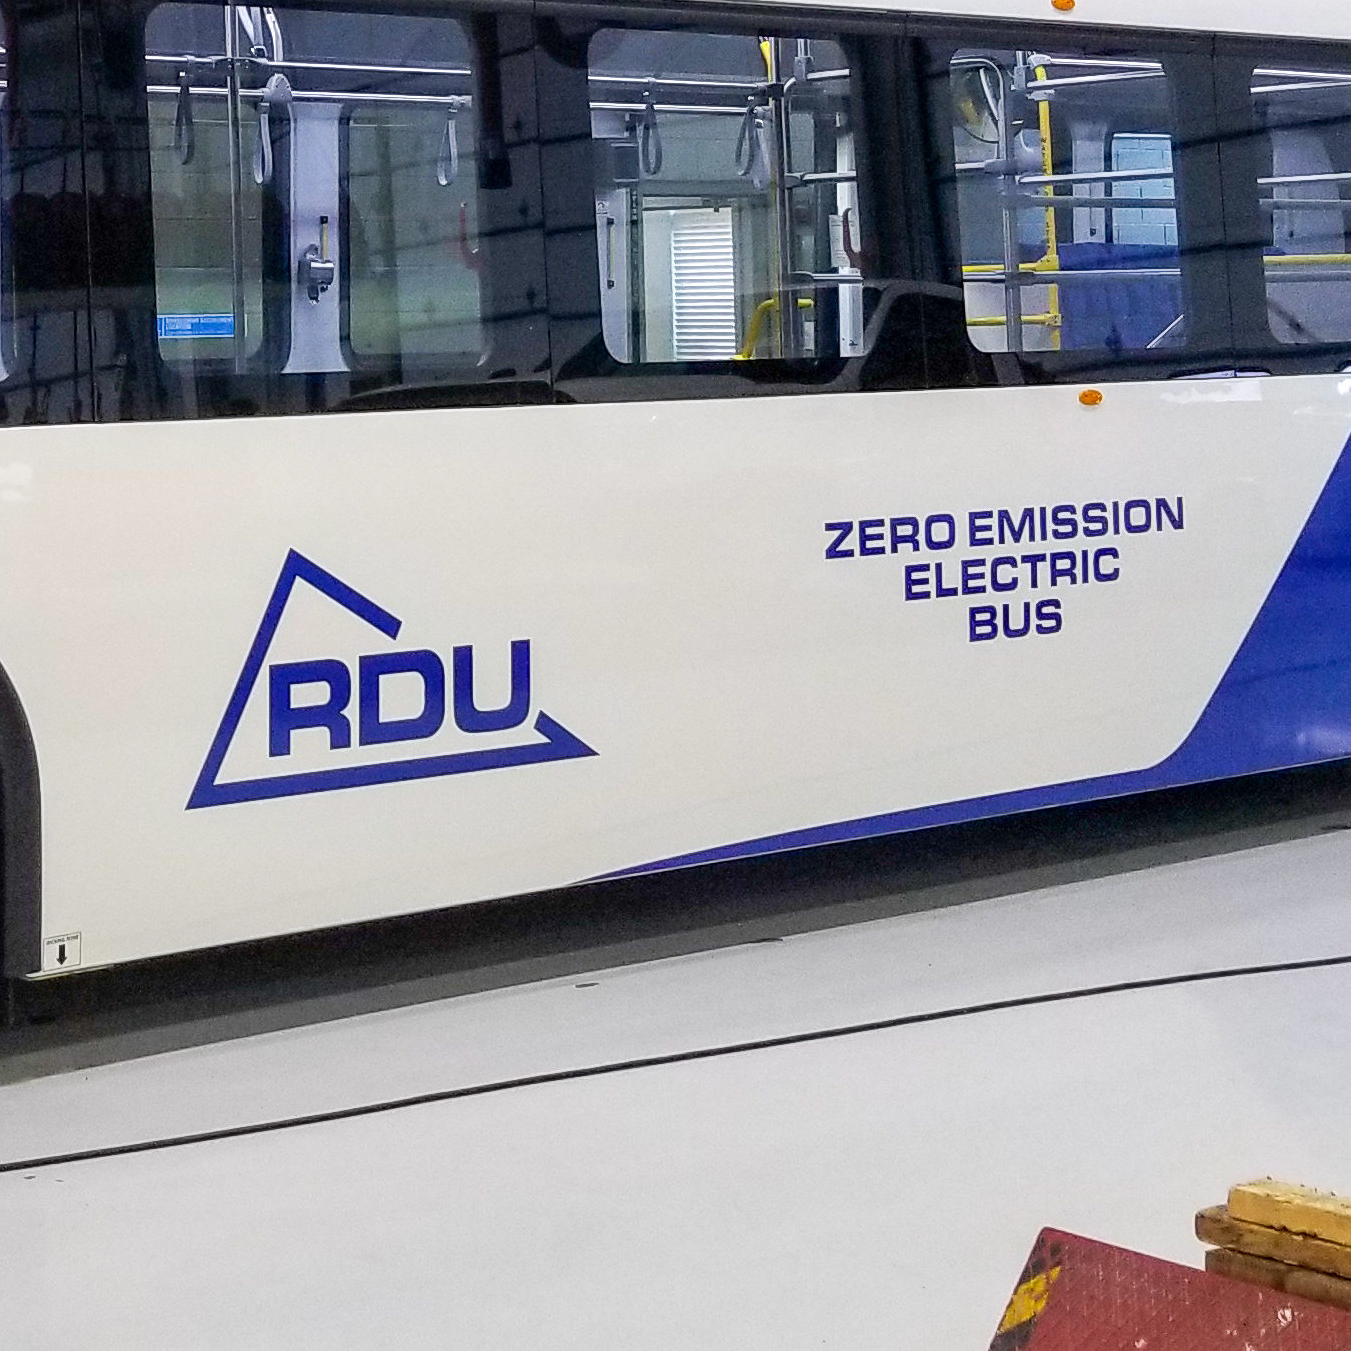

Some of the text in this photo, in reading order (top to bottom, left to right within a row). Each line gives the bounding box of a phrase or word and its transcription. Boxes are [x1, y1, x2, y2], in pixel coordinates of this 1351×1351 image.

[825, 497, 1183, 559] ZERO EMISSION
[905, 547, 1119, 601] ELECTRIC
[969, 599, 1061, 641] BUS
[269, 640, 531, 757] RDU
